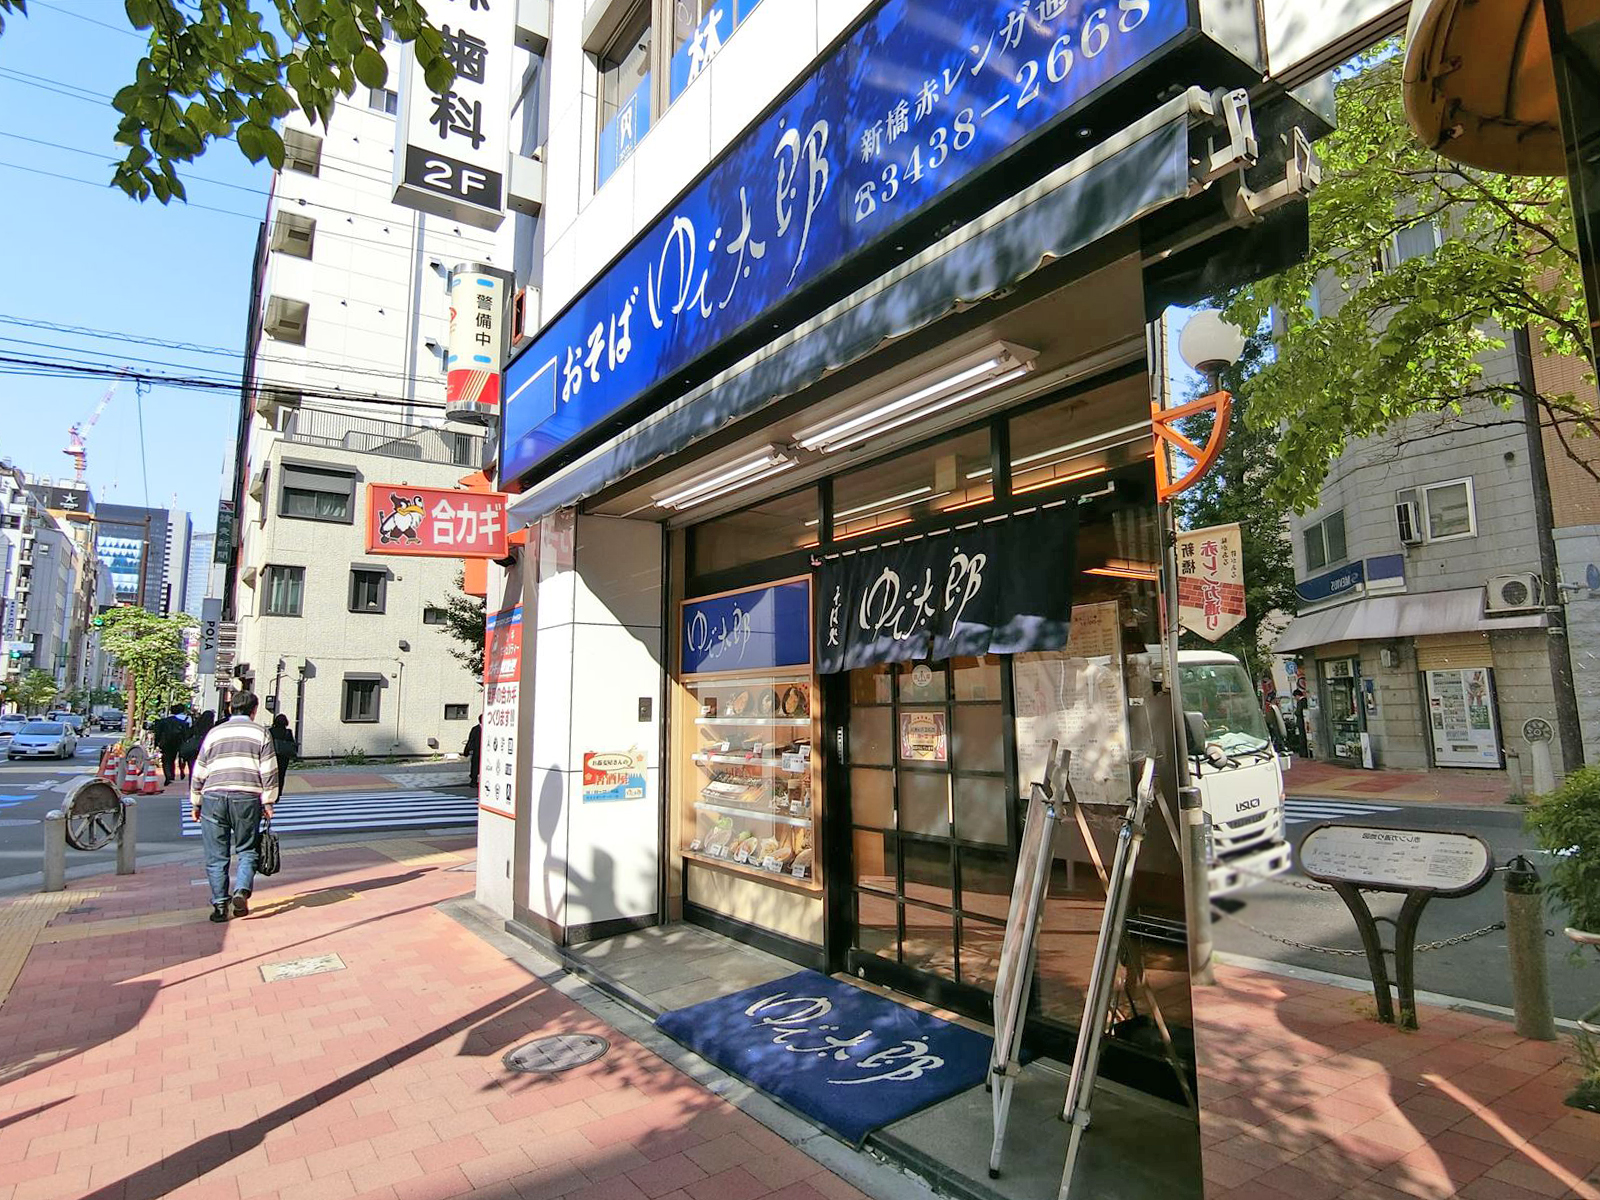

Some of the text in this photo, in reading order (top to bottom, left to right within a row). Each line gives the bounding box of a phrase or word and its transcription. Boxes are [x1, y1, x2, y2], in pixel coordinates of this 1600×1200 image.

[429, 0, 489, 150] 歯科
[423, 160, 487, 195] 2F
[562, 118, 829, 403] おそば ゆで太郎
[475, 293, 493, 347] 警備中
[431, 498, 502, 546] 合カギ
[860, 546, 987, 642] ゆで太郎
[204, 620, 216, 651] POLA
[687, 601, 751, 663] ゆで太郎
[744, 991, 945, 1085] ゆで太郎
